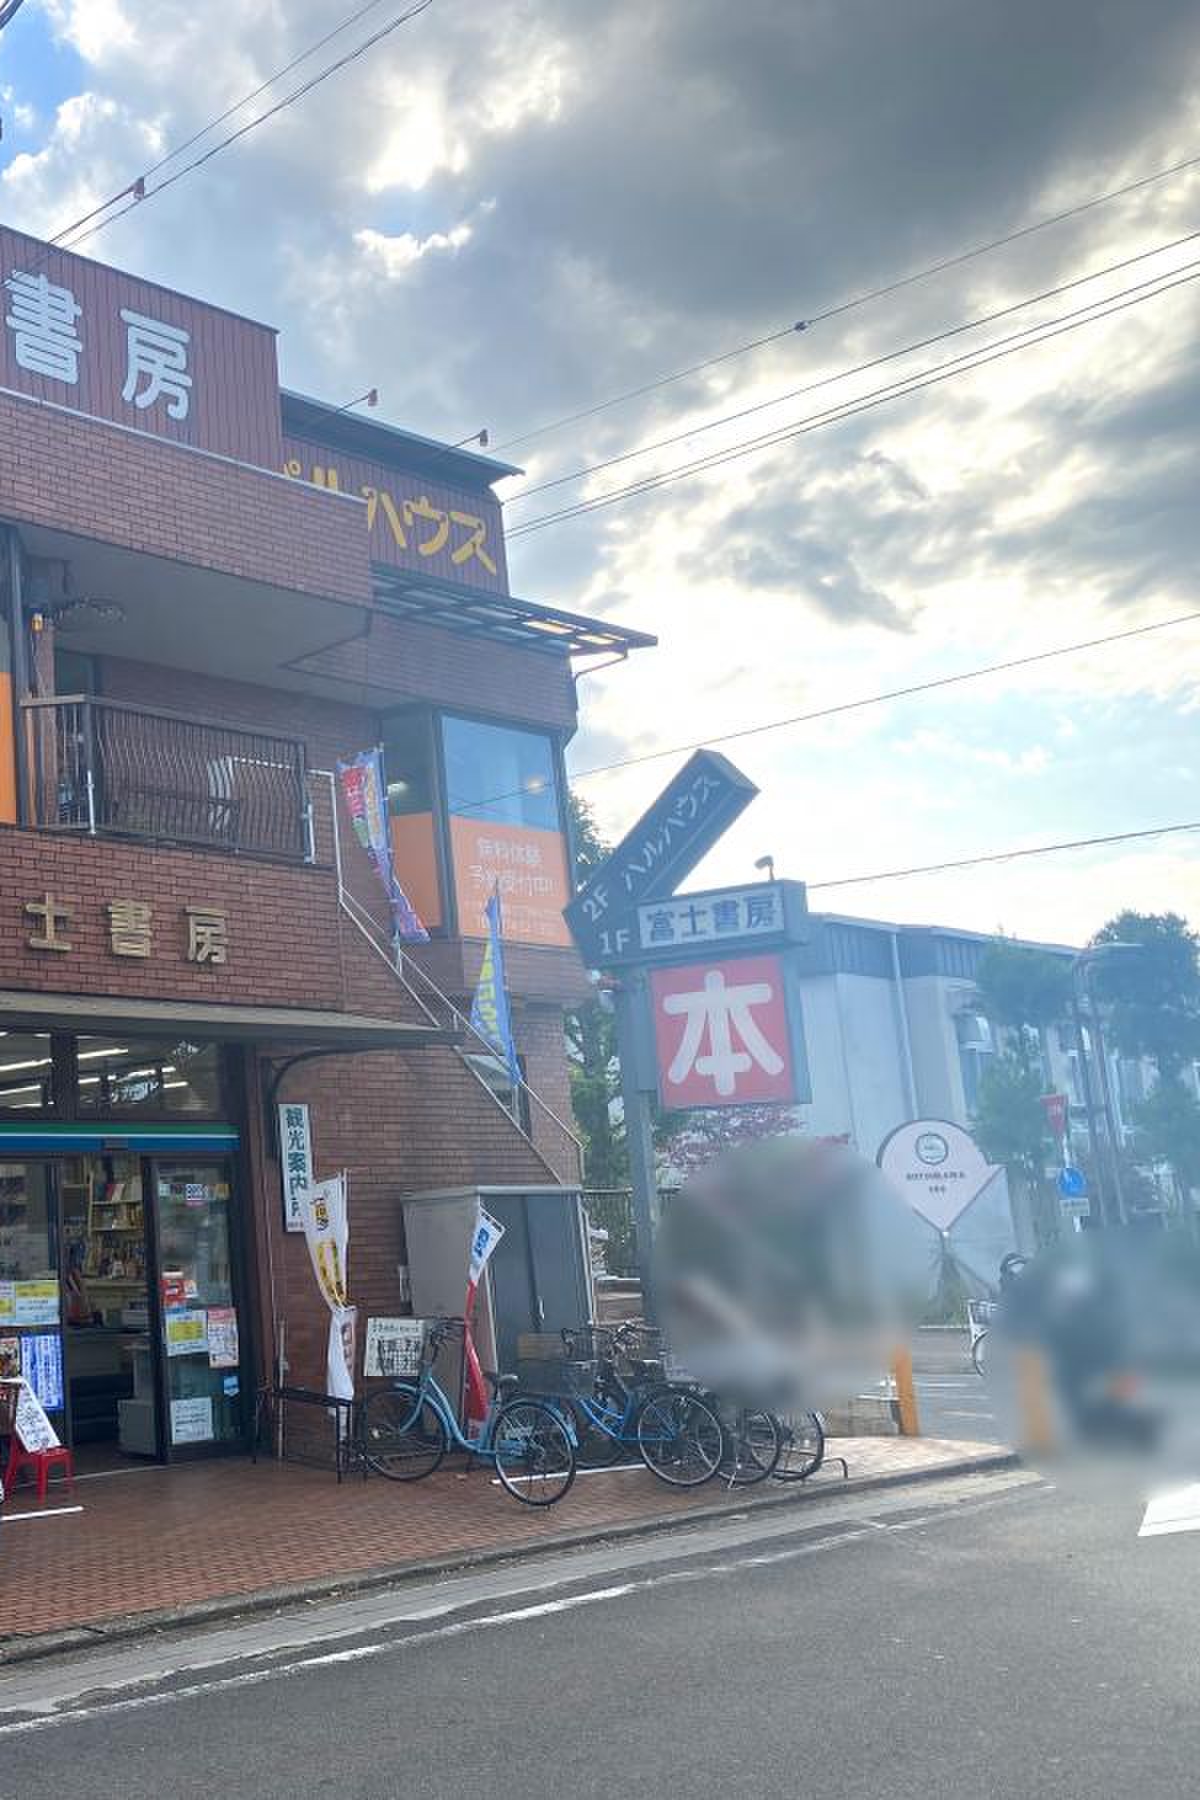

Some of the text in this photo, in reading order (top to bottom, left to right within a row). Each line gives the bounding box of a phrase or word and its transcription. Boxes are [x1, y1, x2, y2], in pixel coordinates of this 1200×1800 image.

[284, 459, 497, 576] ハウス
[601, 894, 777, 954] 1F 富士書房
[662, 970, 786, 1096] 本
